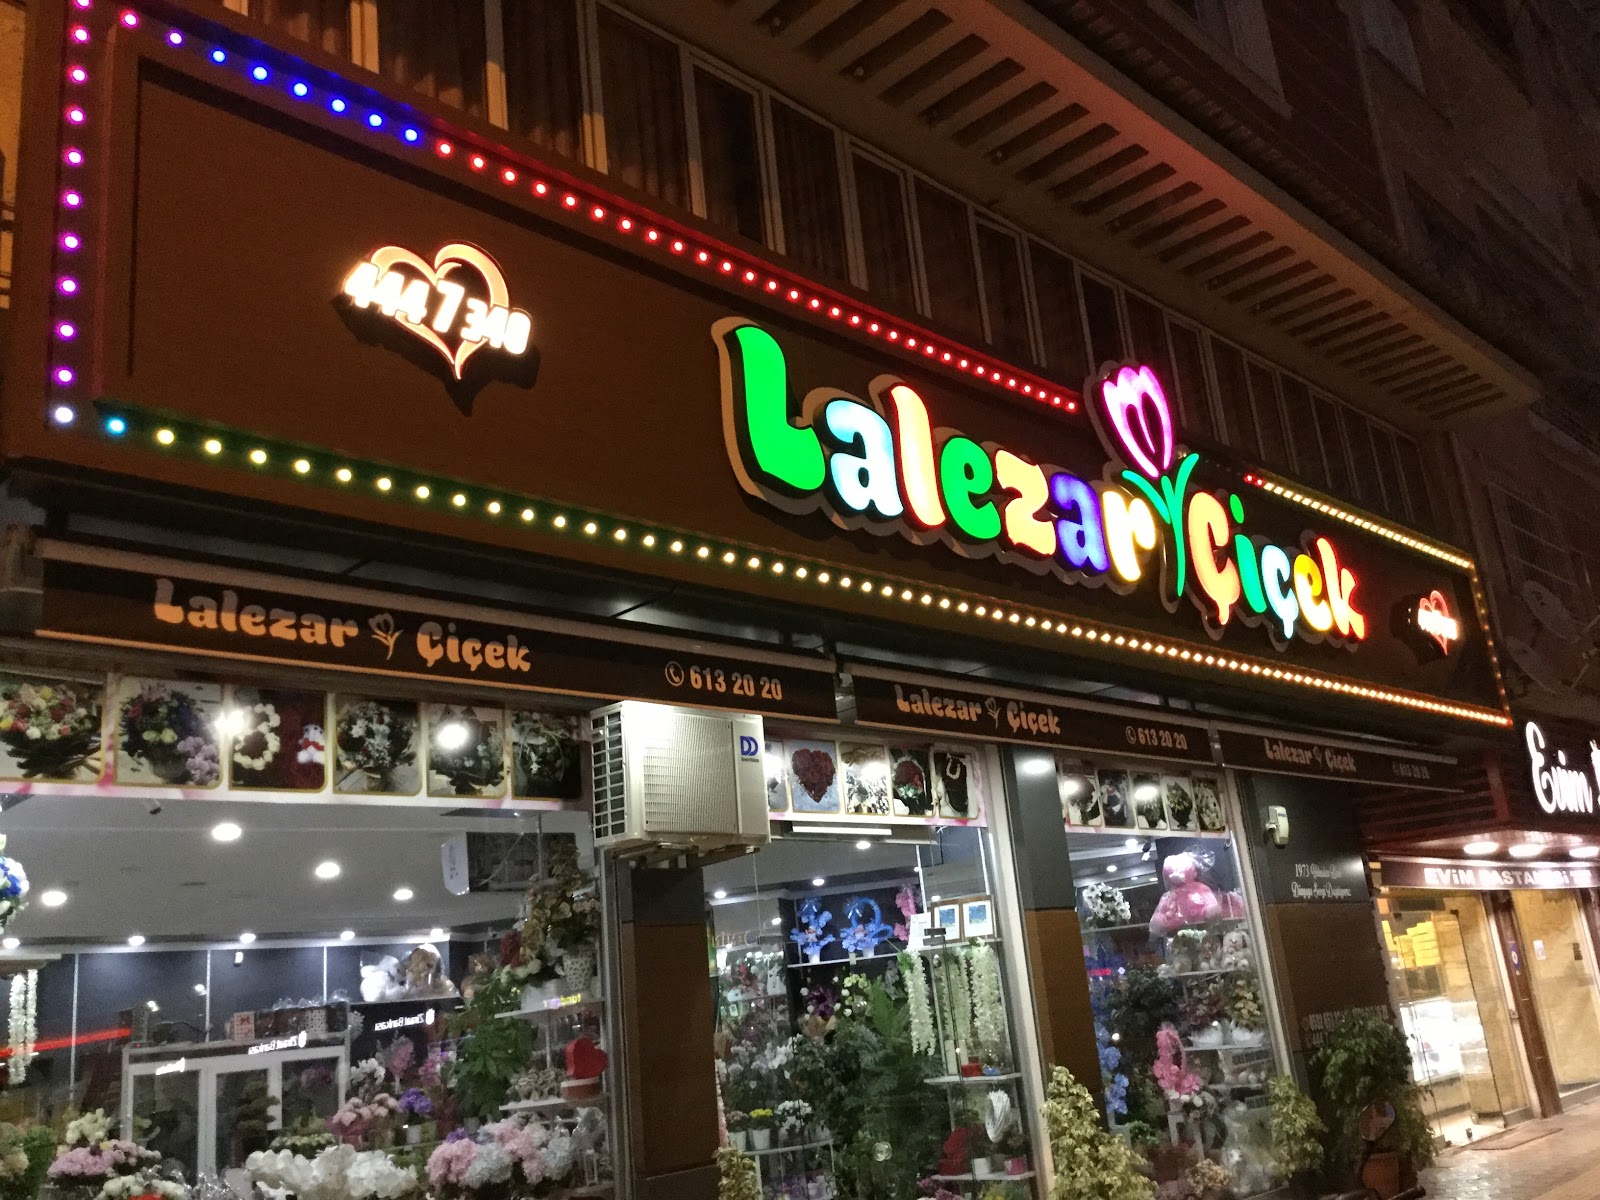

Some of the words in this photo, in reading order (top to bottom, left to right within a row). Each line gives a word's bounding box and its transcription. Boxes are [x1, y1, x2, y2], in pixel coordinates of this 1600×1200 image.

[343, 261, 430, 325] 444
[433, 280, 465, 333] 7
[461, 298, 532, 355] 340
[735, 326, 1155, 582] Lalezar
[1188, 491, 1365, 639] Çiçek
[154, 577, 359, 647] Lalezar
[416, 621, 532, 672] Çiçek
[690, 665, 727, 693] 613
[731, 672, 756, 697] 20
[760, 677, 783, 700] 20
[894, 684, 982, 722] Lalezar
[1007, 701, 1061, 735] Çiçek
[1138, 727, 1158, 746] 613
[1159, 730, 1173, 748] 20
[1174, 732, 1188, 750] 20
[1263, 738, 1312, 765] Lalezar
